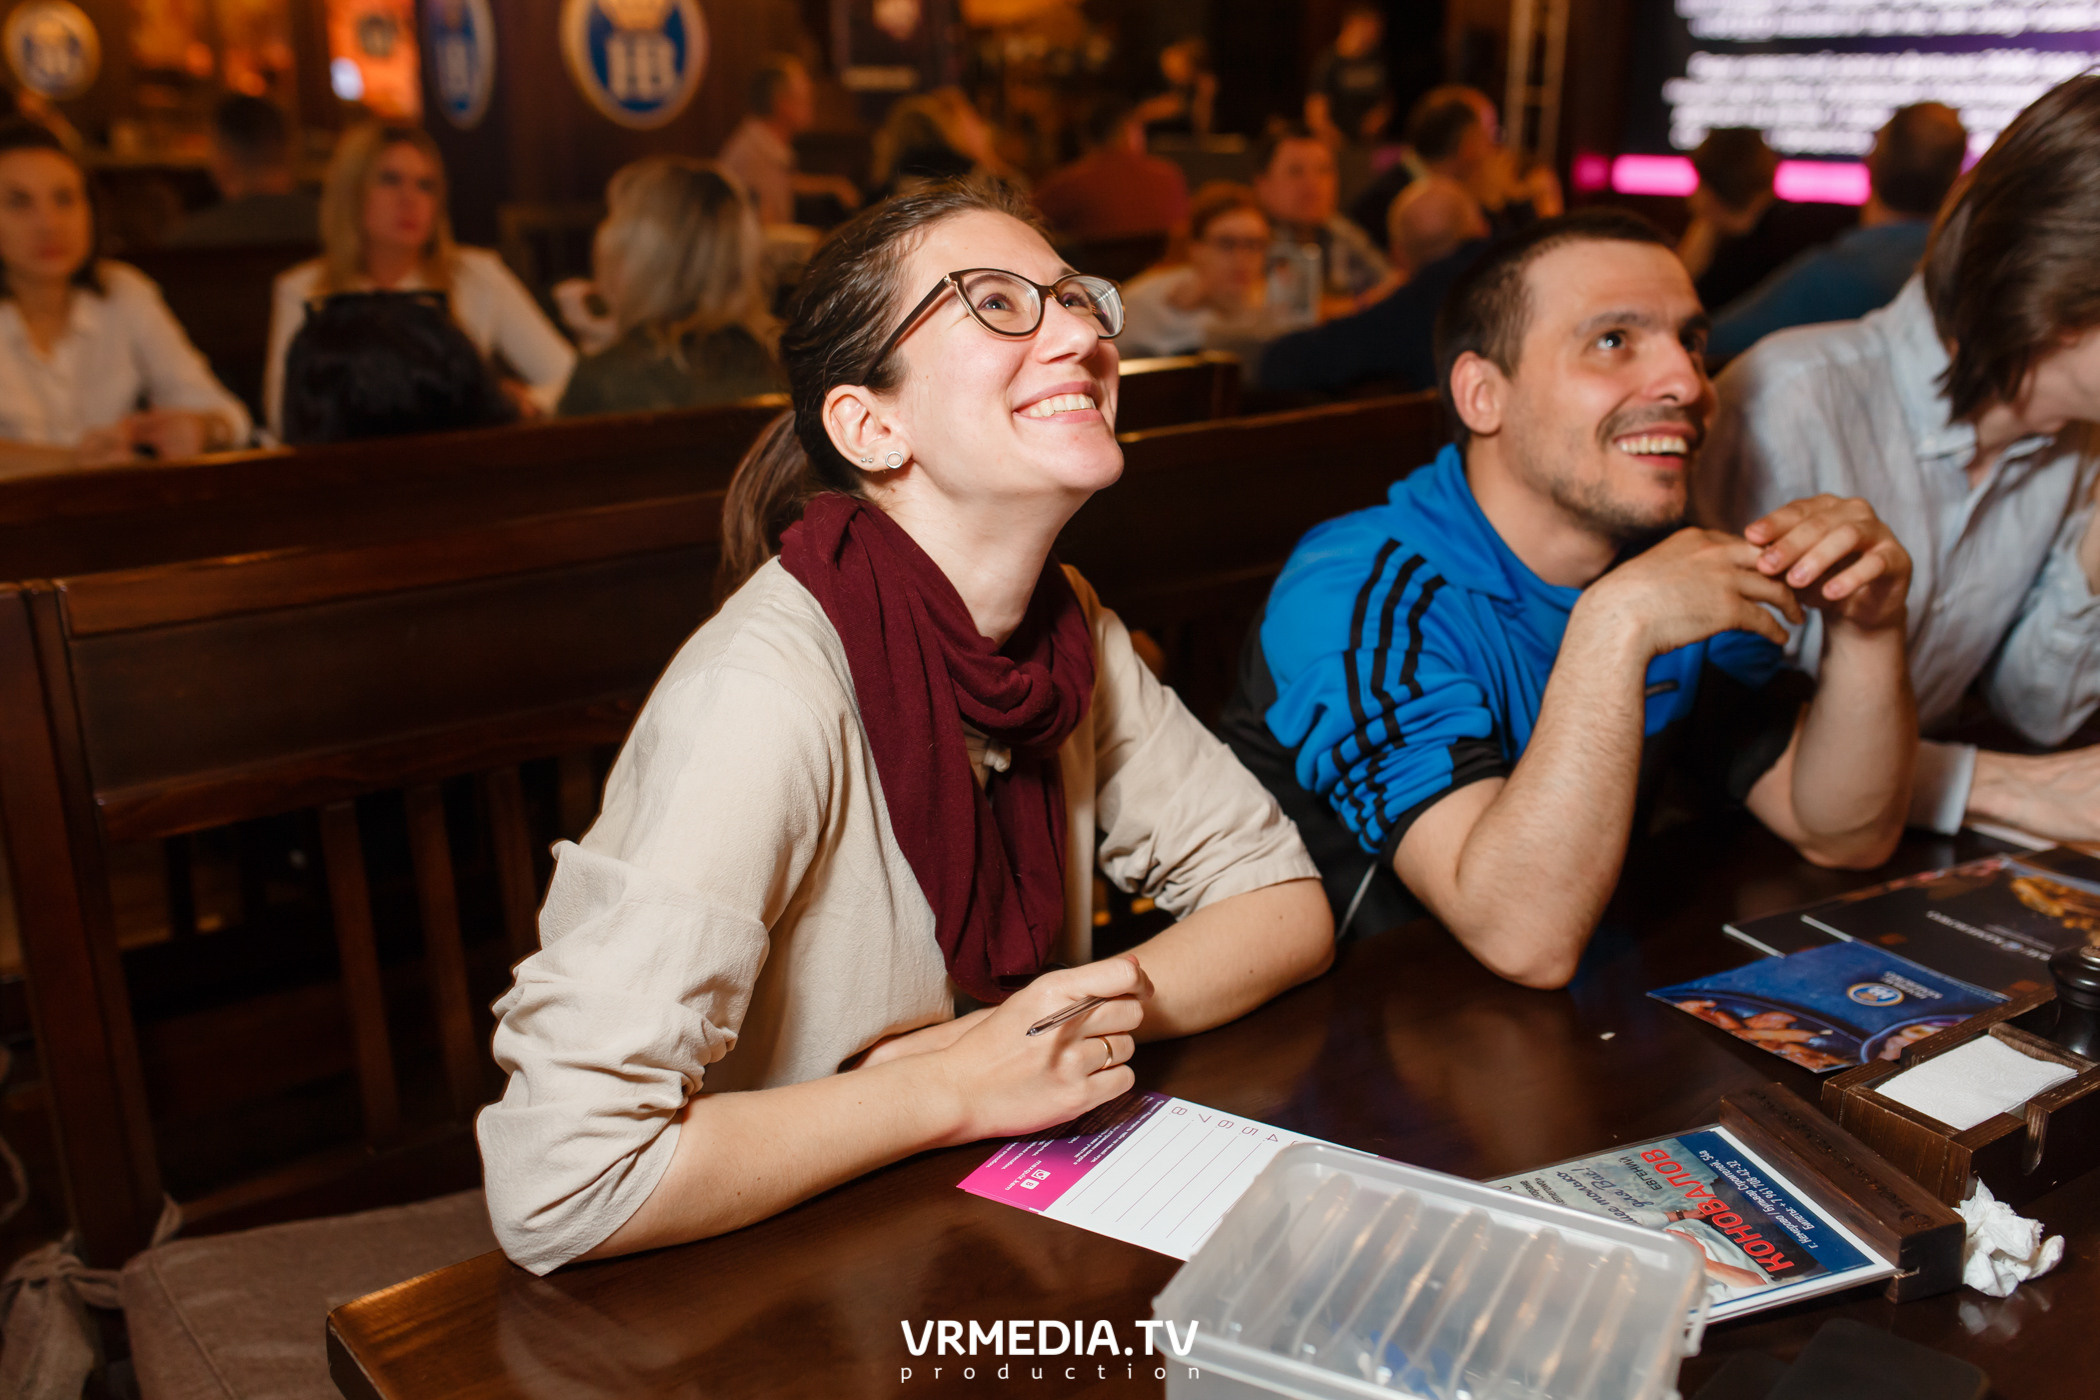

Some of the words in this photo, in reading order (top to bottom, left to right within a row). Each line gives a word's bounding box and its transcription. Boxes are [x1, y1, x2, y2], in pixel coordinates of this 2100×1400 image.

[1620, 1156, 1662, 1191] ЕВГЕНИЙ
[1640, 1148, 1794, 1272] КОНОВАЛОВ
[1746, 1189, 1775, 1212] Бульвар
[1776, 1214, 1812, 1244] Кемерово
